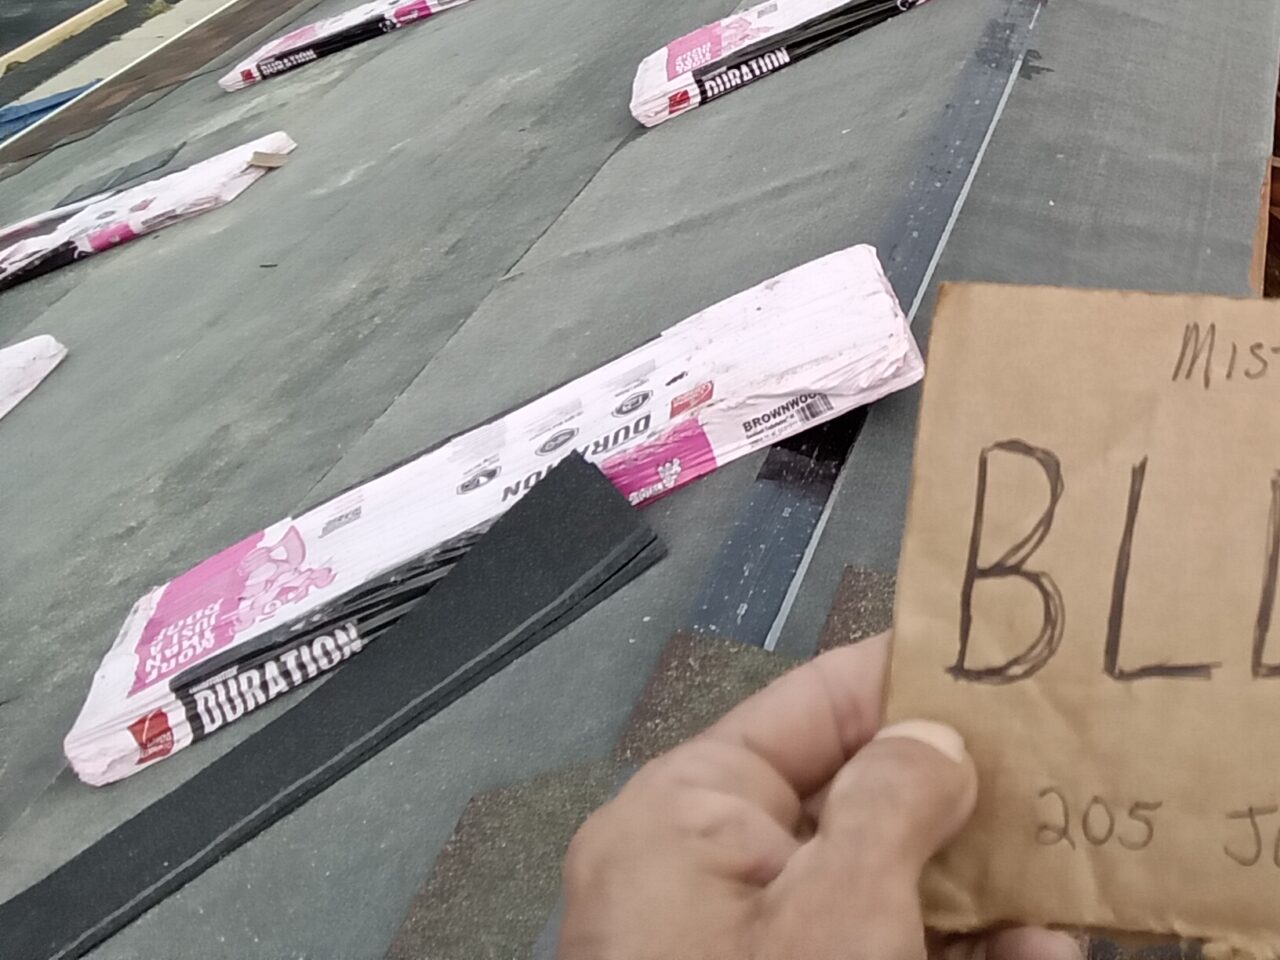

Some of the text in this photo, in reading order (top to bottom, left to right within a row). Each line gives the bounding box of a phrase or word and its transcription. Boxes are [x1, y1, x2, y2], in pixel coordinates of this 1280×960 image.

[259, 48, 318, 78] DURATION
[704, 46, 792, 98] DURATION
[743, 391, 829, 433] BROWNWOO
[193, 620, 366, 733] DURATION
[1035, 787, 1163, 849] 205
